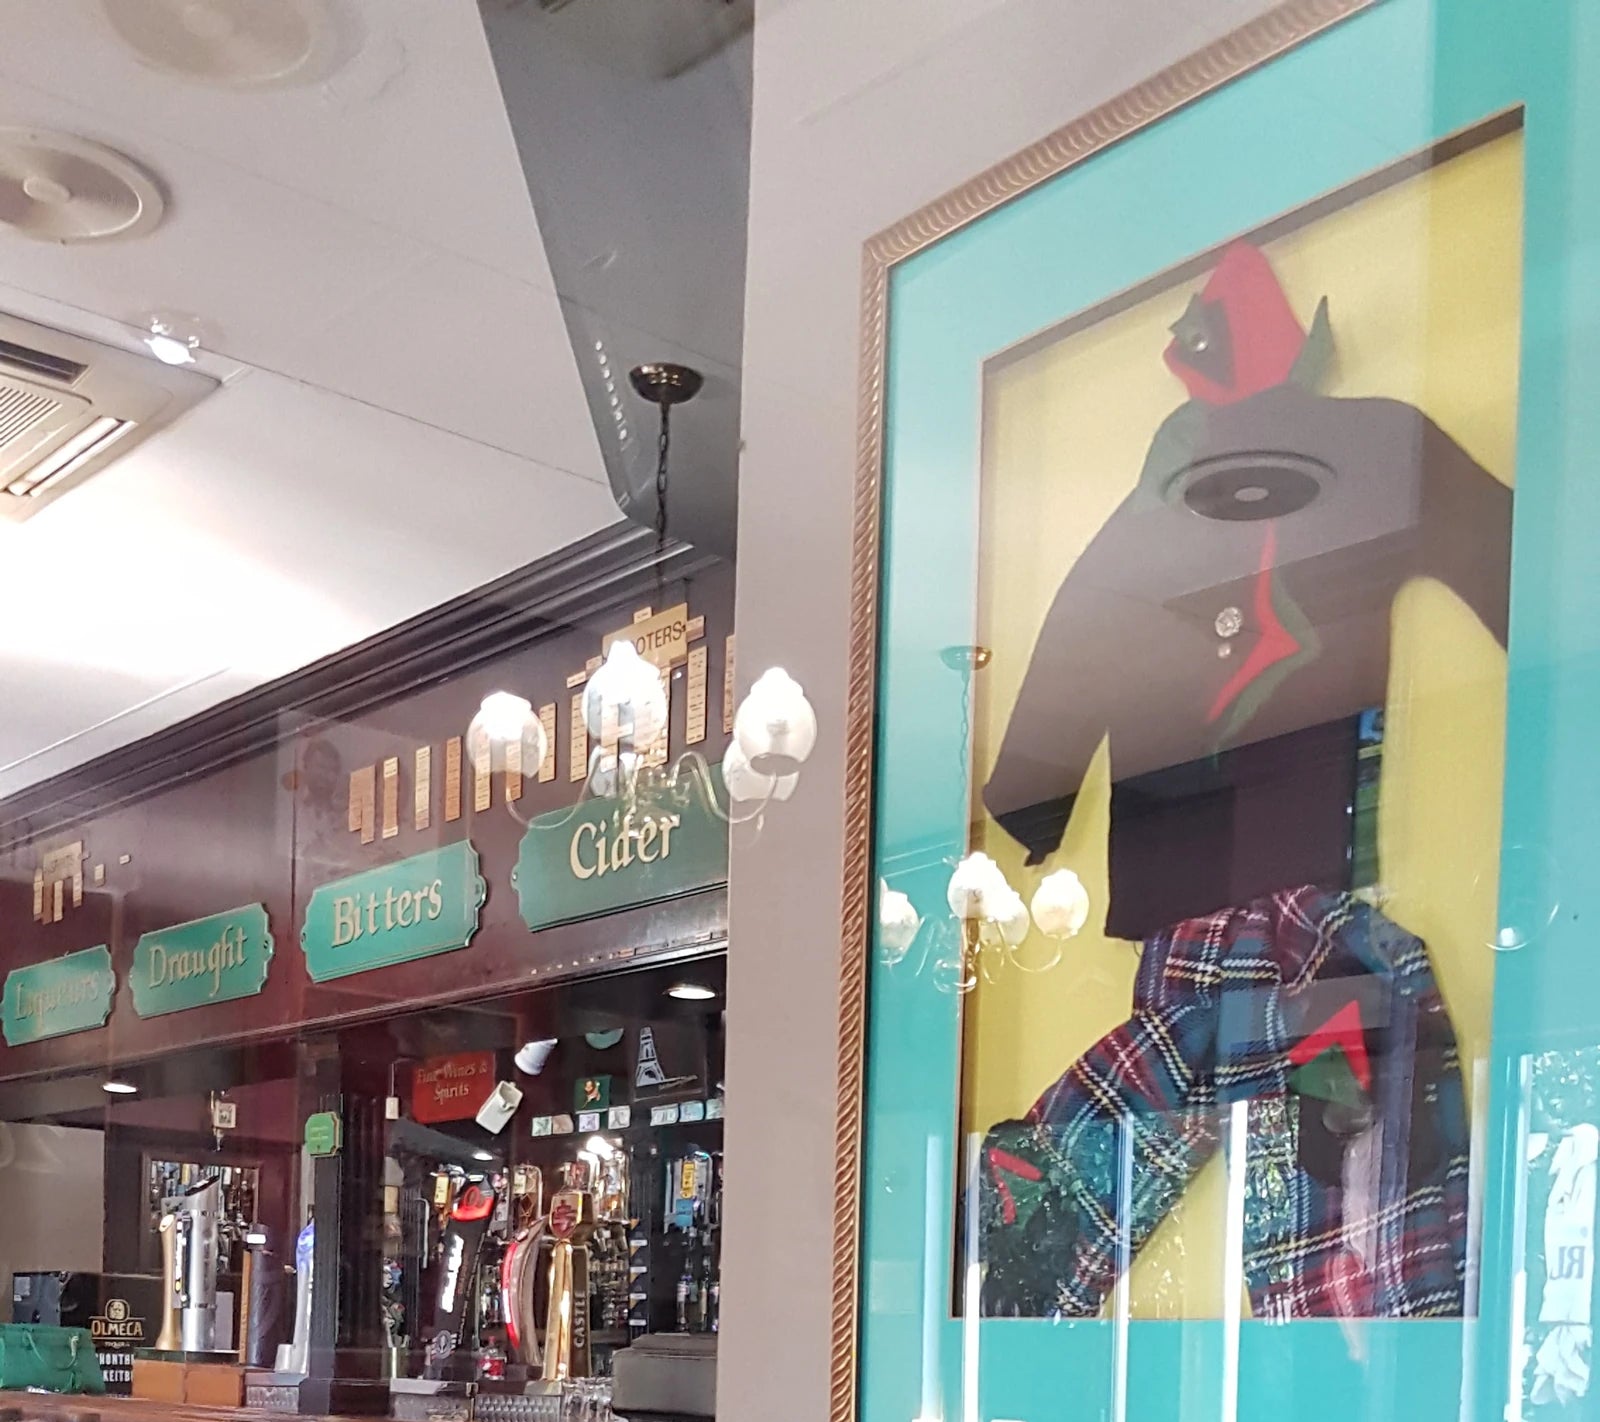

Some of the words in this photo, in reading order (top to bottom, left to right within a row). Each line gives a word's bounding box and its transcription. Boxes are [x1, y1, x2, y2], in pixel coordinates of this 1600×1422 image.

[635, 620, 682, 656] OTERS
[569, 809, 681, 880] Cider
[332, 878, 443, 948] Bitters
[149, 925, 248, 998] Draught
[433, 1082, 470, 1105] Spirits
[91, 1319, 143, 1336] OLMECA
[573, 1290, 586, 1348] CASTLE
